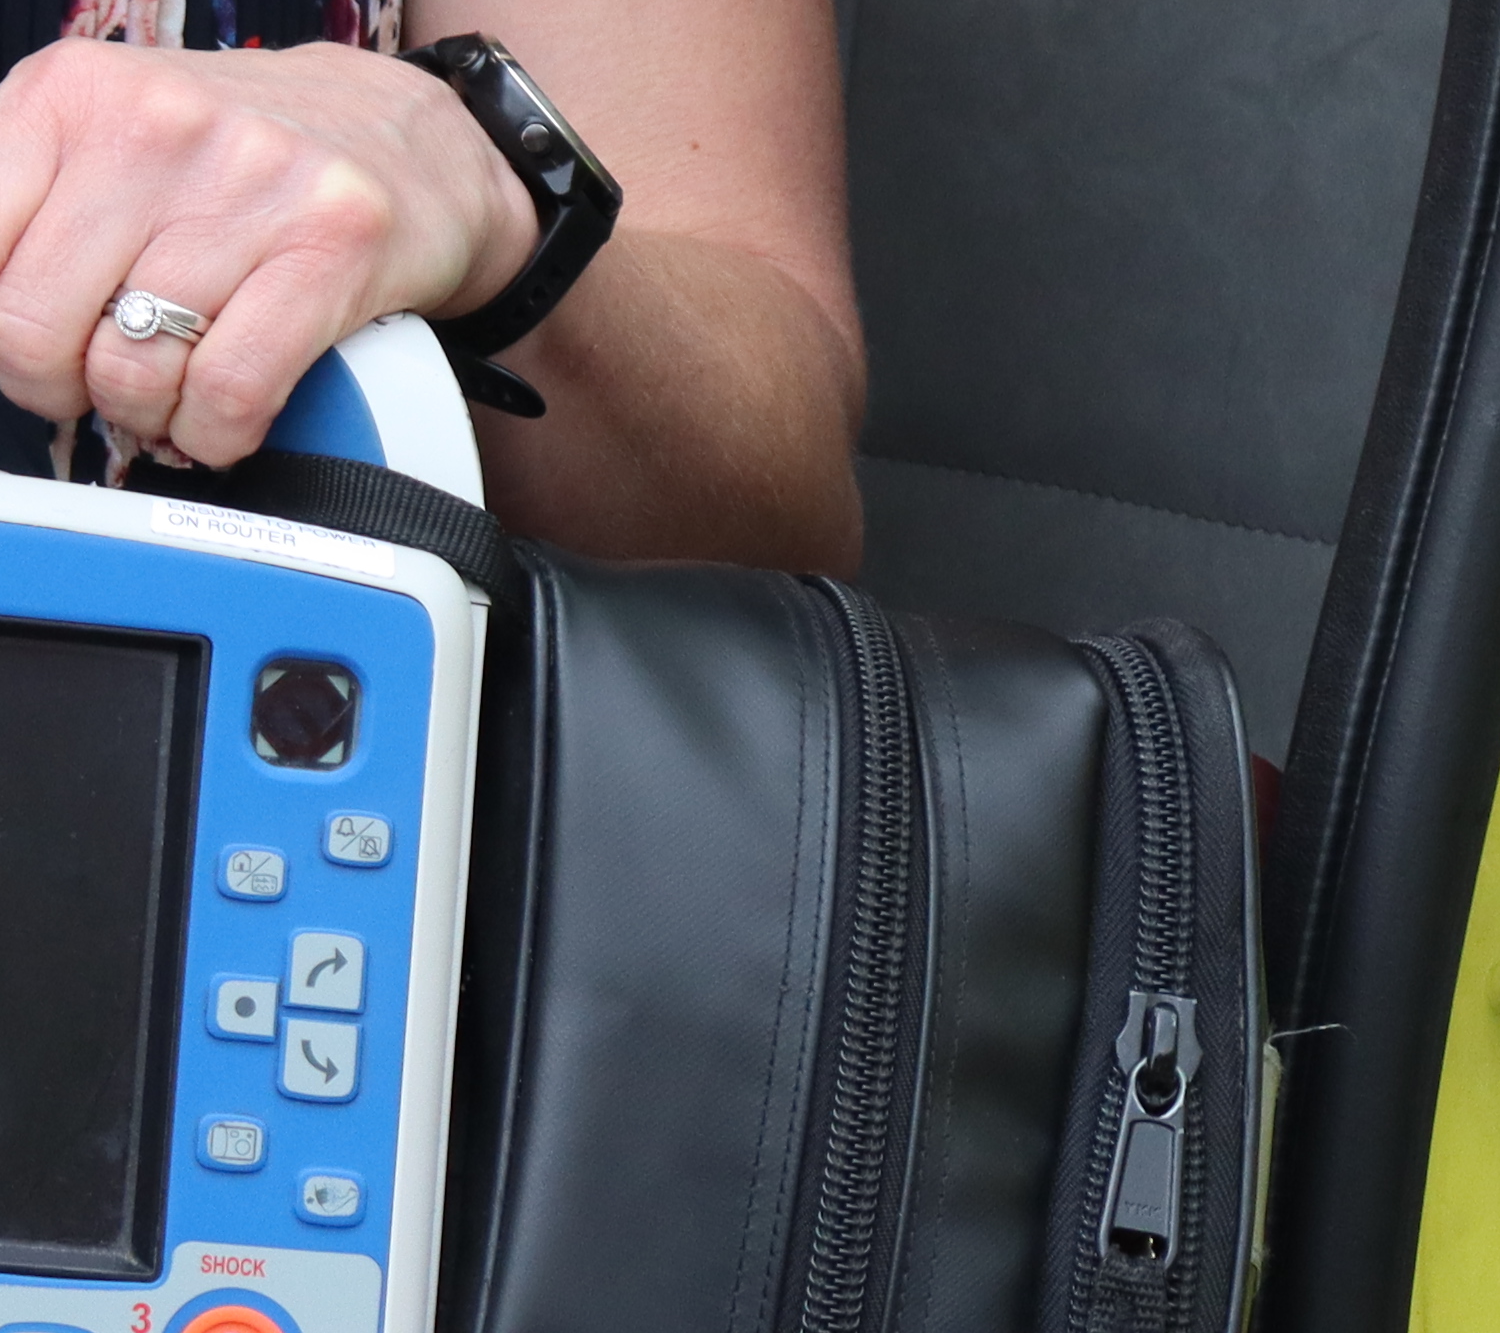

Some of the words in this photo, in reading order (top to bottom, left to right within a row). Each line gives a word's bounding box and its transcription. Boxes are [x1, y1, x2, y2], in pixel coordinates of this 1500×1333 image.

[168, 512, 200, 530] ON
[207, 517, 297, 548] ROUTER
[263, 516, 293, 531] TO
[297, 525, 377, 549] POWER
[200, 1254, 267, 1278] SHOCK
[130, 1302, 152, 1333] 3
